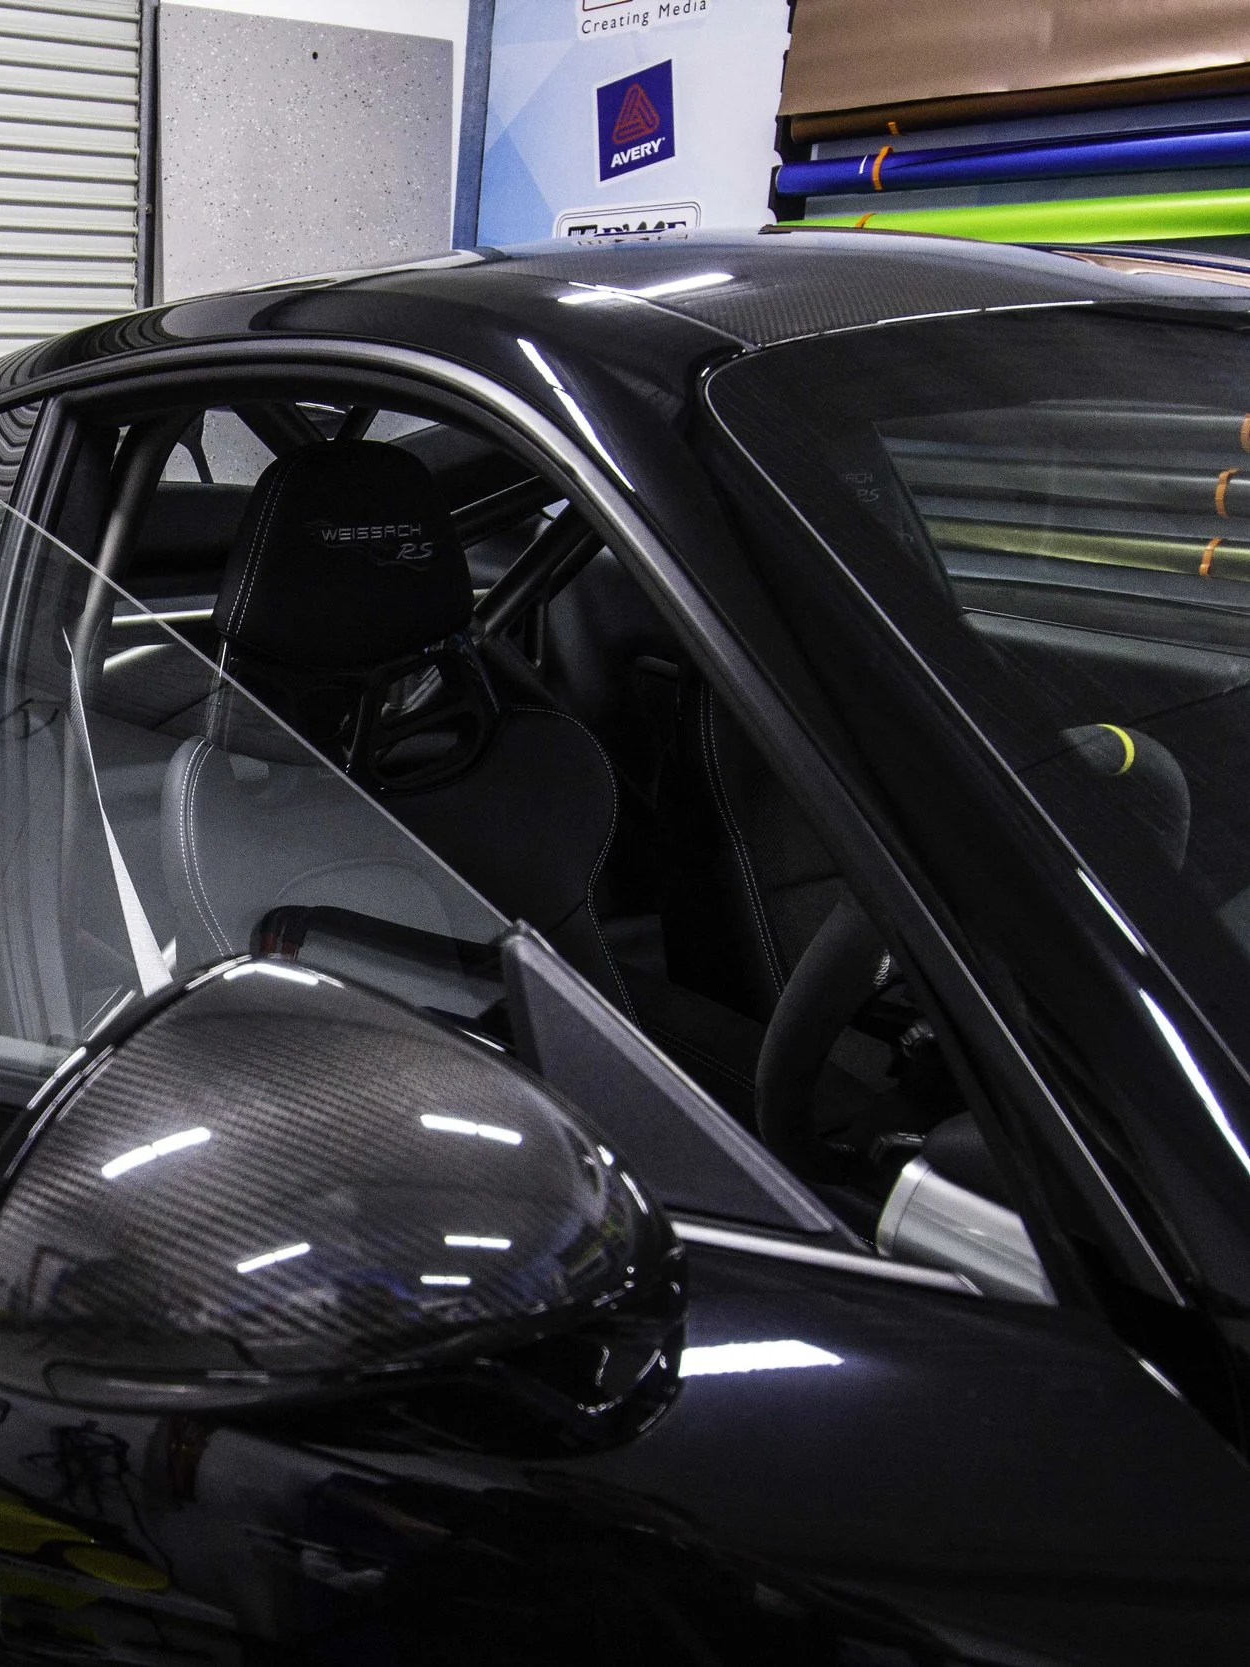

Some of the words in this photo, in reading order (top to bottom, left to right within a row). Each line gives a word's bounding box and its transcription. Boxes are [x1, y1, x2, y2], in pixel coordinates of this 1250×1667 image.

[581, 11, 650, 34] Creating
[658, 0, 707, 19] Media
[610, 138, 663, 168] AVERY
[321, 523, 422, 541] WEISSACH
[395, 542, 434, 560] RS
